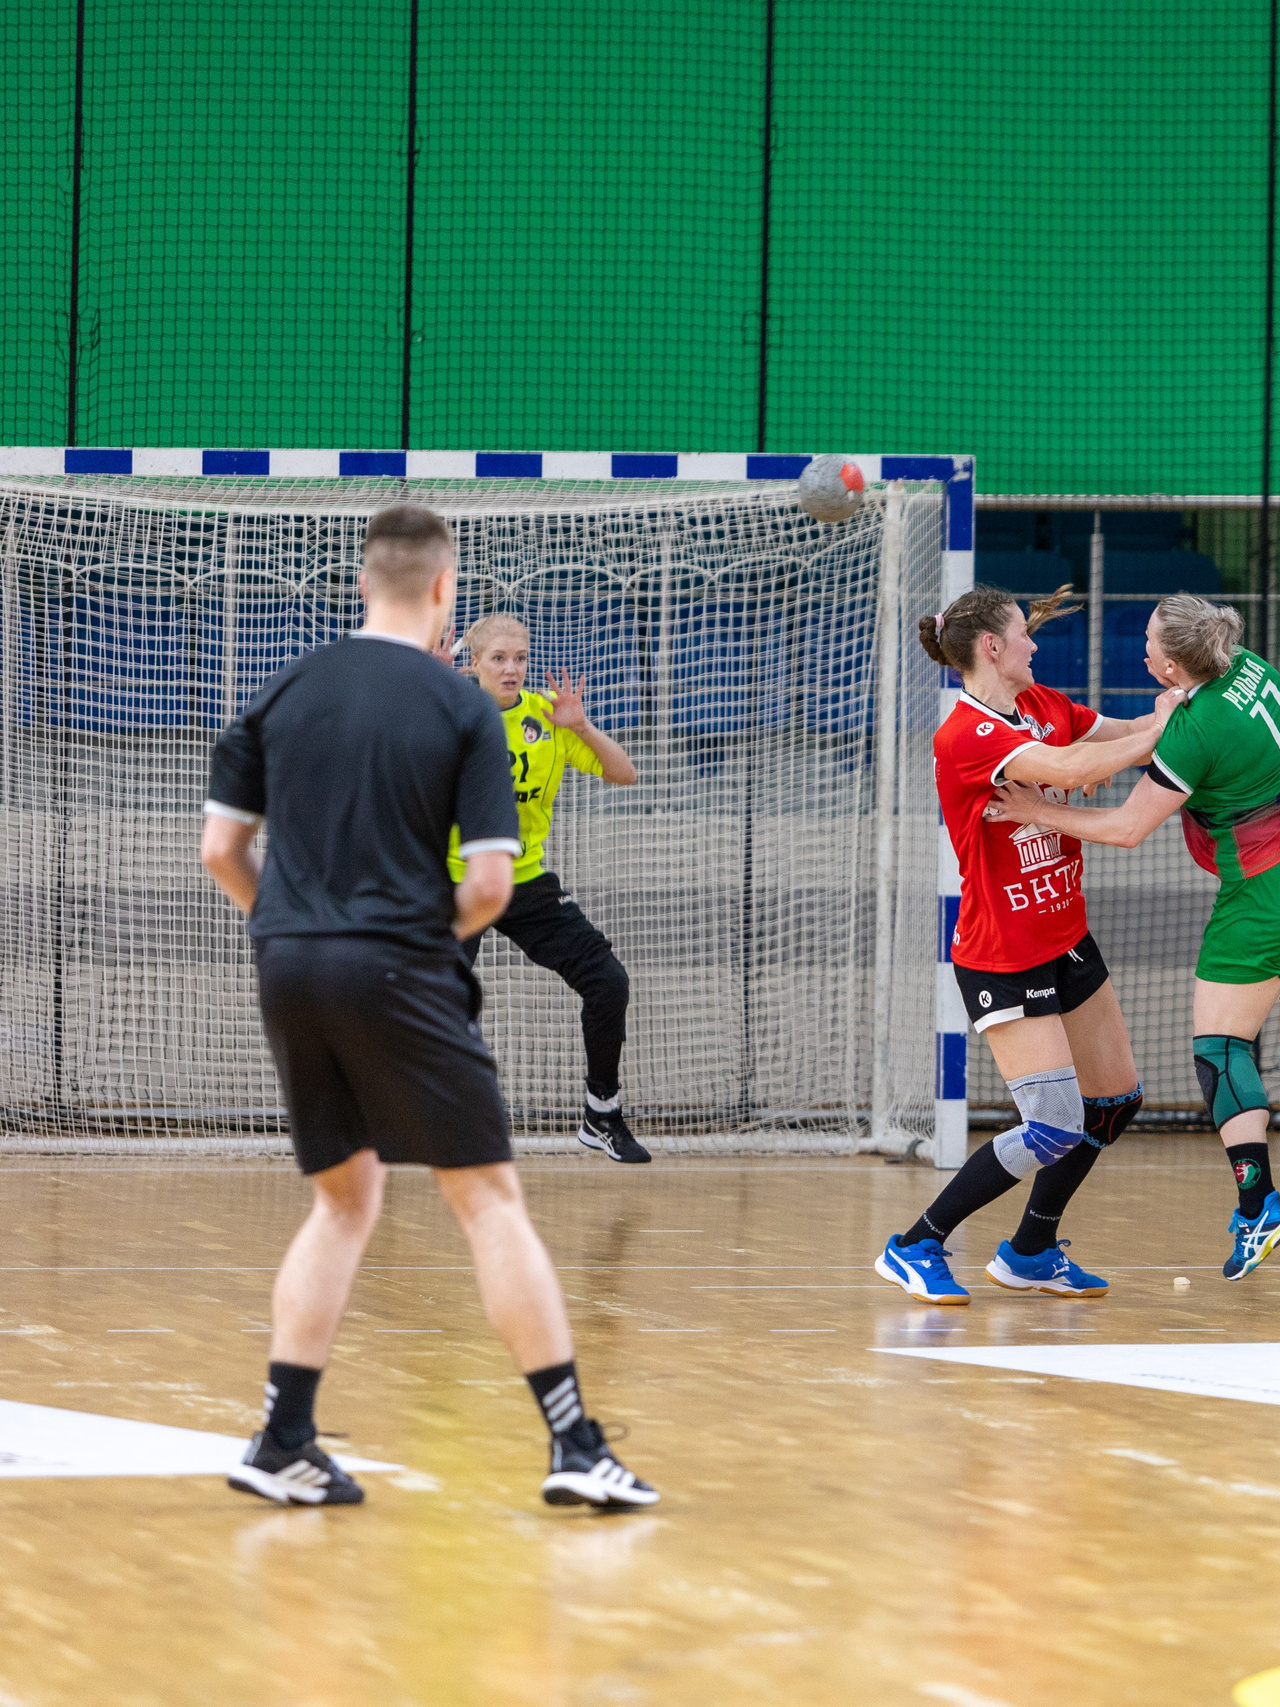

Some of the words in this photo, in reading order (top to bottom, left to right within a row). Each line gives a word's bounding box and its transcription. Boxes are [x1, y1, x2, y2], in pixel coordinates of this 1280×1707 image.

[1221, 657, 1266, 712] РЕДЬКА
[1003, 859, 1080, 912] БНТУ
[1026, 986, 1056, 999] Kempa
